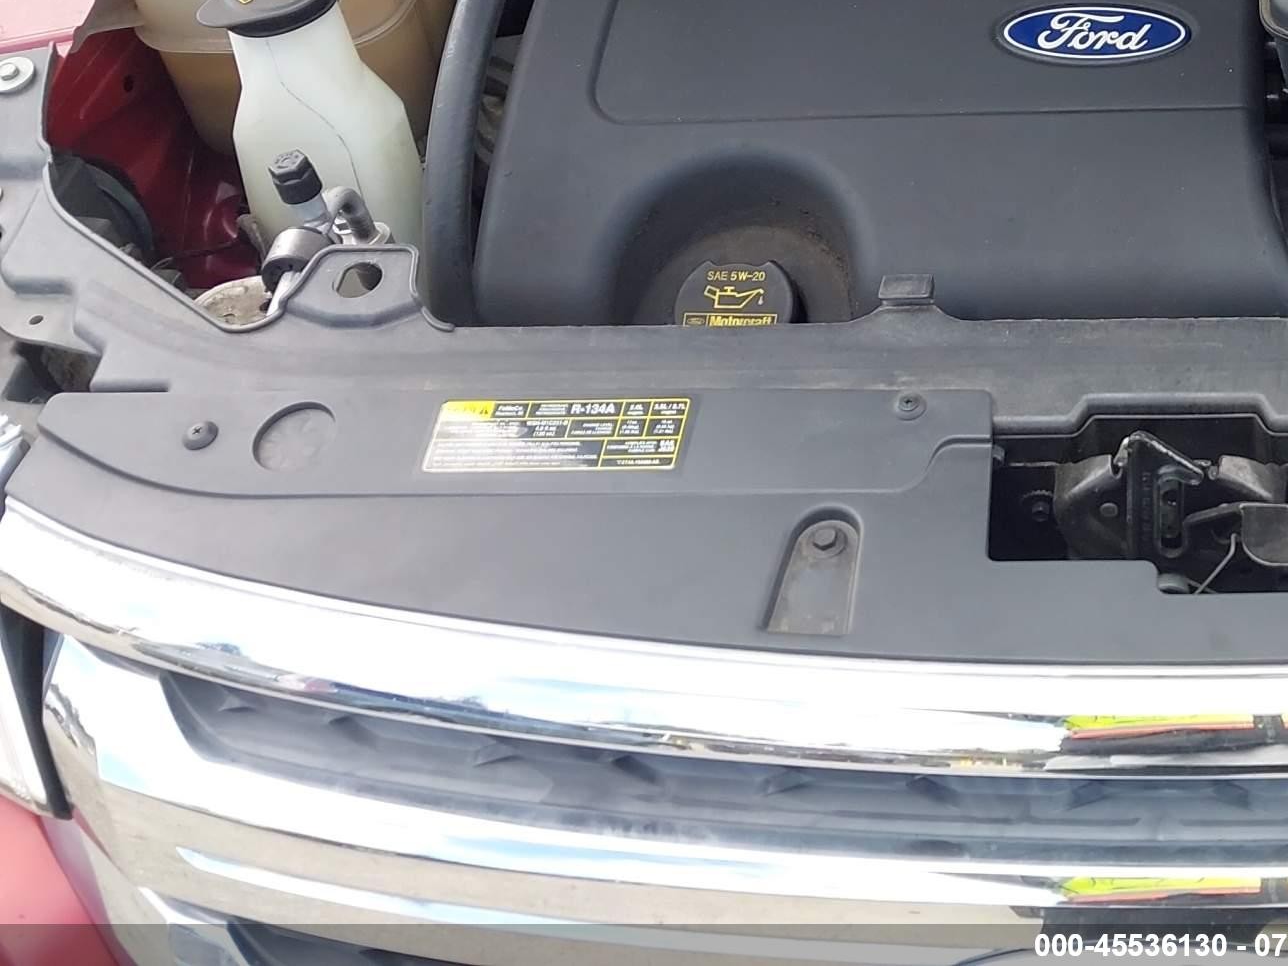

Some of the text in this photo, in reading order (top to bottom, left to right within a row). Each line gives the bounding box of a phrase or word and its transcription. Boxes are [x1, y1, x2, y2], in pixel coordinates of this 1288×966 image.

[1037, 12, 1152, 50] Ford
[707, 270, 766, 281] SAE 5W-20
[570, 403, 615, 414] R-134A
